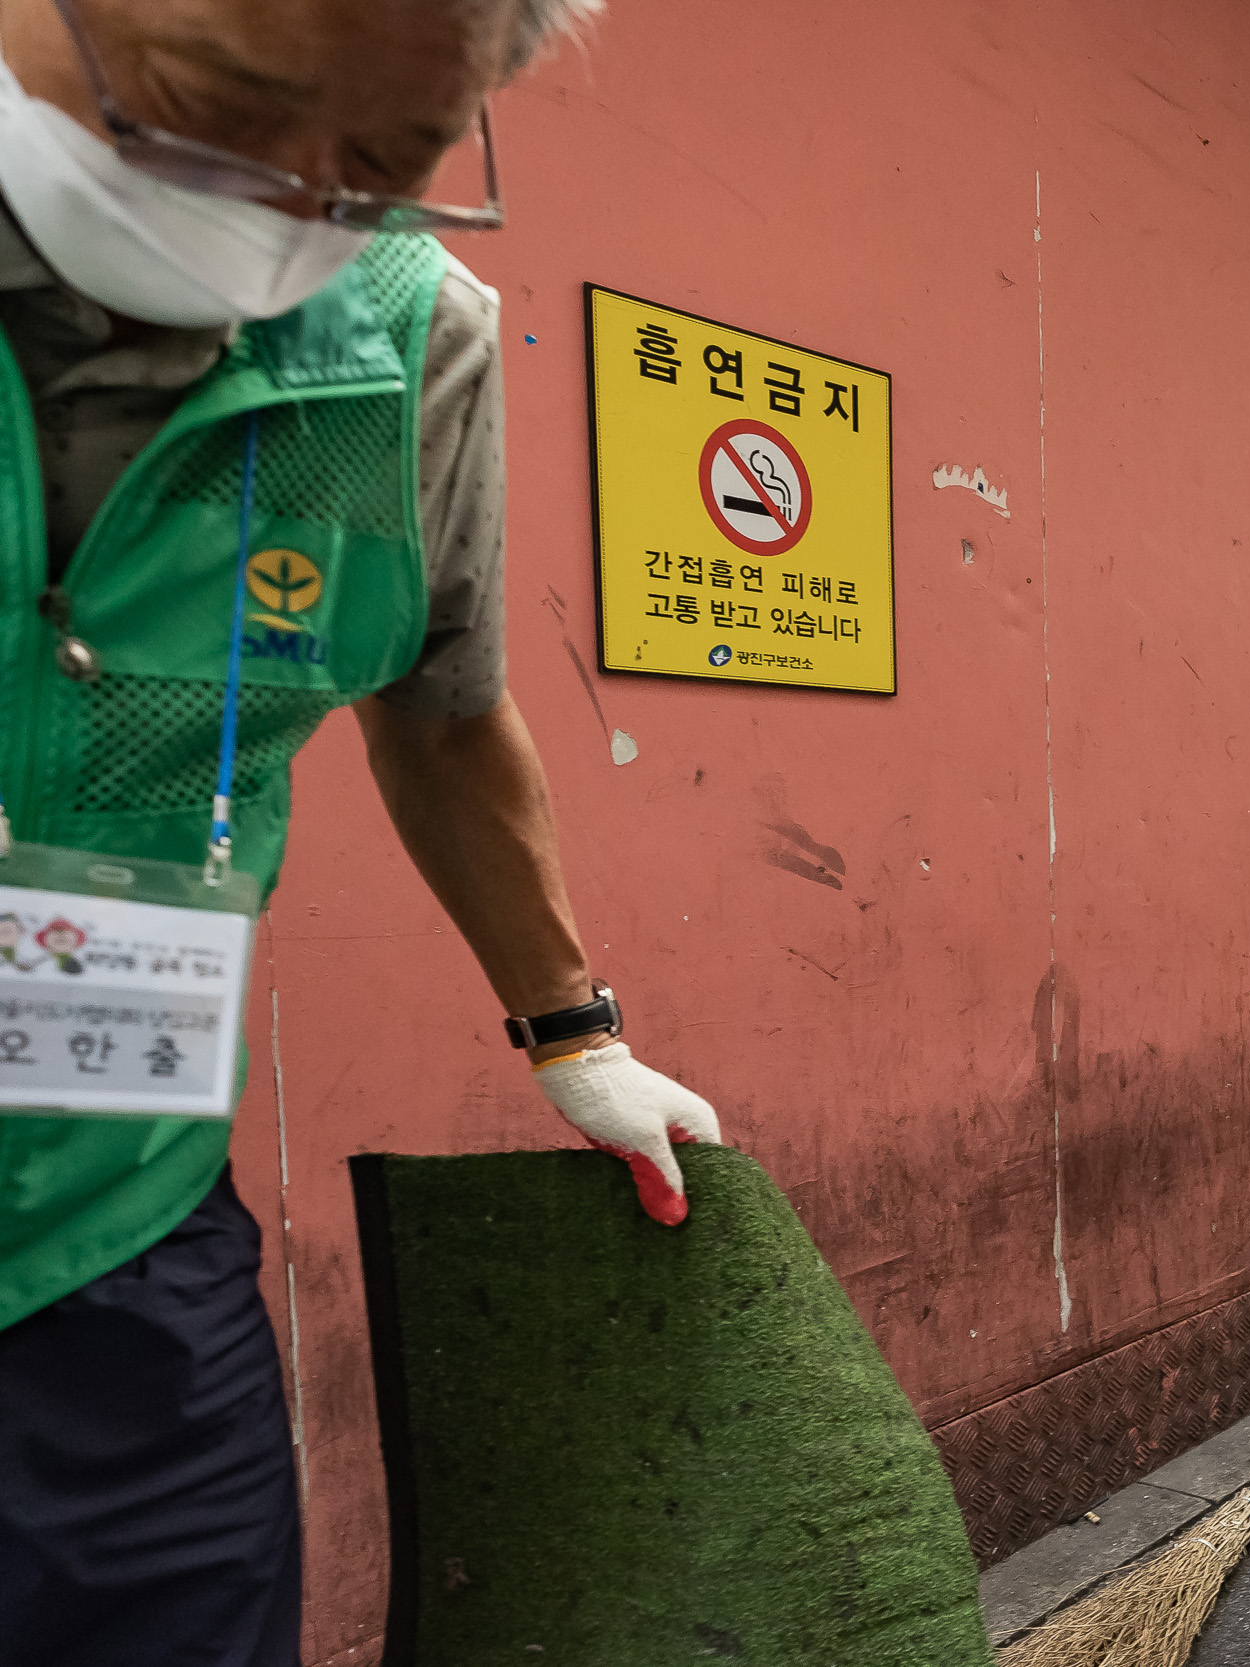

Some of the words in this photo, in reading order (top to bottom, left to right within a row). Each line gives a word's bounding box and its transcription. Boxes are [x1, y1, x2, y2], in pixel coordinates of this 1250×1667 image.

[633, 322, 860, 433] 흡연금지
[644, 550, 764, 593] 간접흡연
[781, 572, 859, 605] 피해로
[645, 593, 701, 625] 고통
[710, 600, 762, 629] 받고
[770, 608, 862, 643] 있습니다
[736, 650, 814, 670] 광진구보건소
